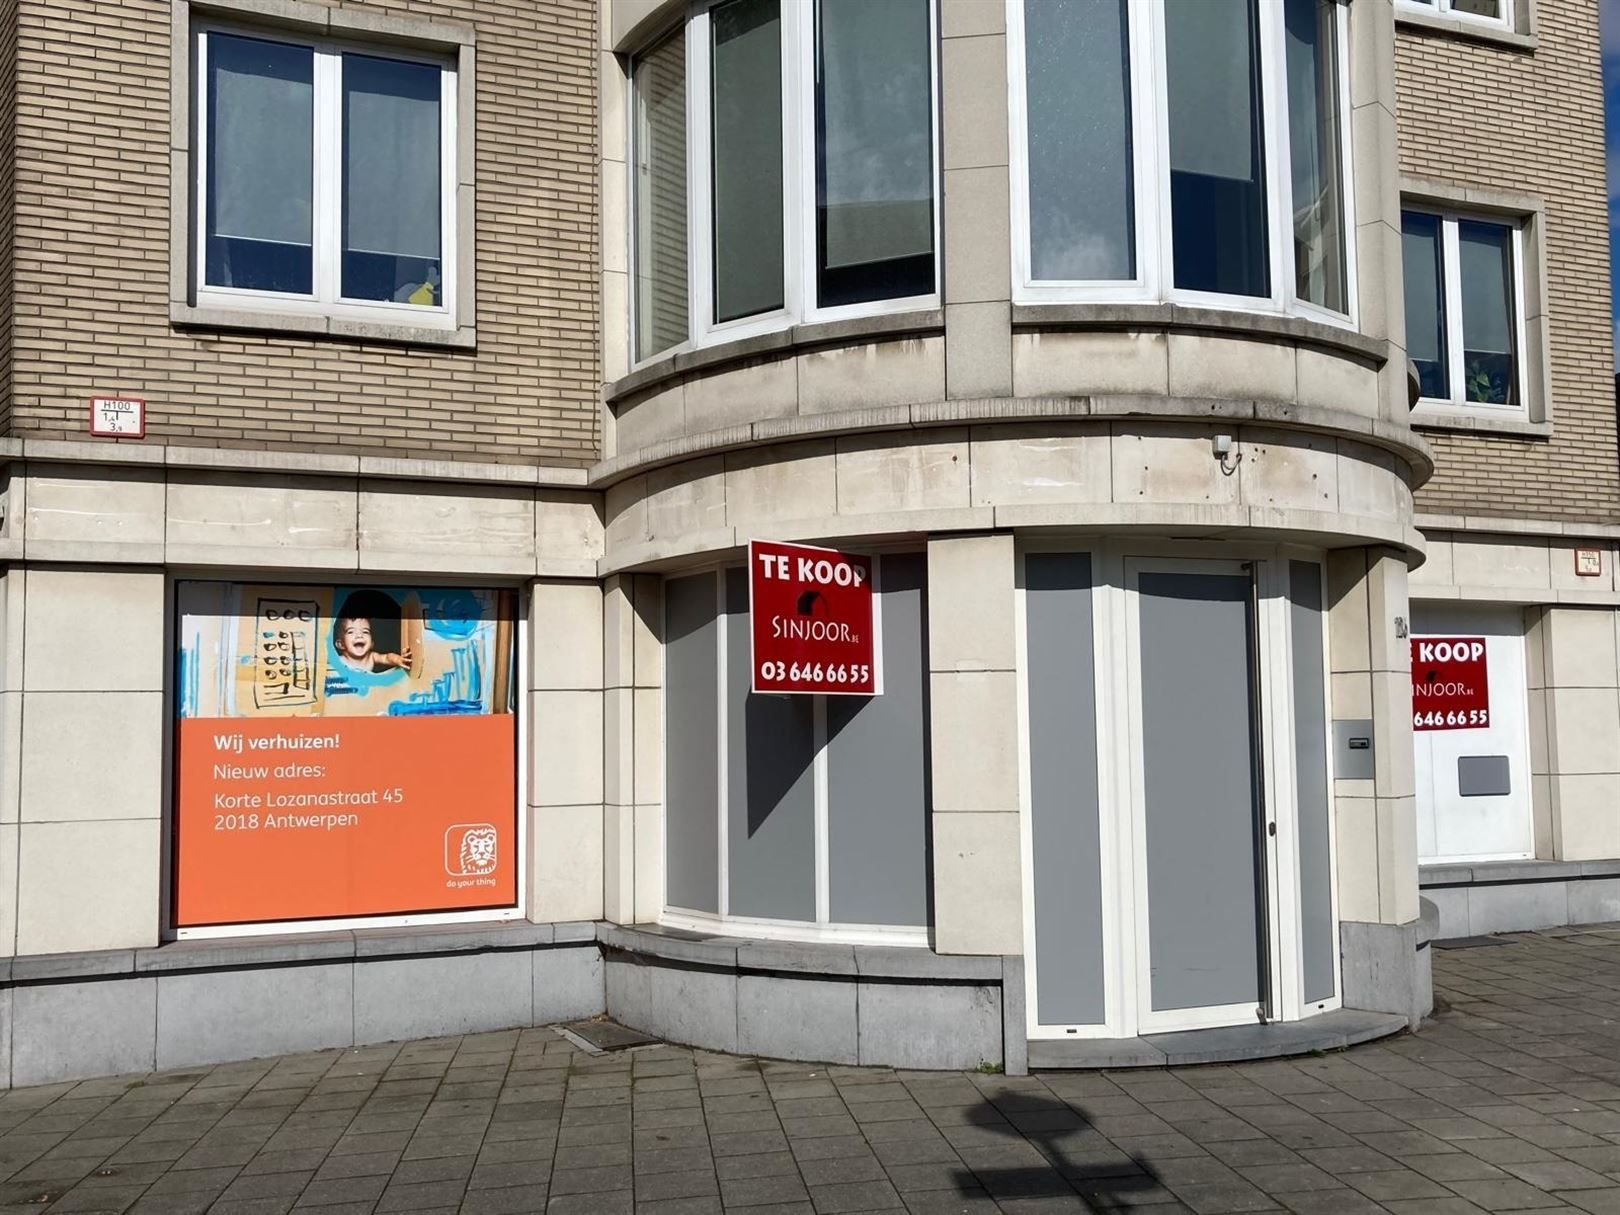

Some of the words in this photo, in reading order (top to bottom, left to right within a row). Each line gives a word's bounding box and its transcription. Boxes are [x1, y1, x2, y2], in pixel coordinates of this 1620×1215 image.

[103, 400, 131, 410] H100
[759, 553, 790, 581] TE
[797, 557, 866, 588] KOOP
[1419, 642, 1484, 663] KOOP
[761, 660, 786, 681] 03
[789, 661, 824, 682] 646
[826, 663, 848, 683] 66
[850, 664, 869, 684] 55
[1411, 682, 1474, 697] INJOOR.BE
[1414, 711, 1444, 727] 646
[1447, 710, 1467, 725] 66
[1469, 709, 1487, 724] 55
[213, 735, 243, 754] Wij
[249, 734, 340, 750] verhuizen!
[213, 764, 269, 780] Nieuw
[274, 762, 326, 778] adres:
[214, 793, 262, 809] Korte
[266, 789, 379, 808] Lozanastraat
[382, 788, 404, 803] 45
[214, 814, 259, 831] 2018
[264, 813, 359, 831] Antwerpen
[446, 879, 457, 888] do
[457, 880, 475, 889] your
[476, 878, 497, 887] thing
